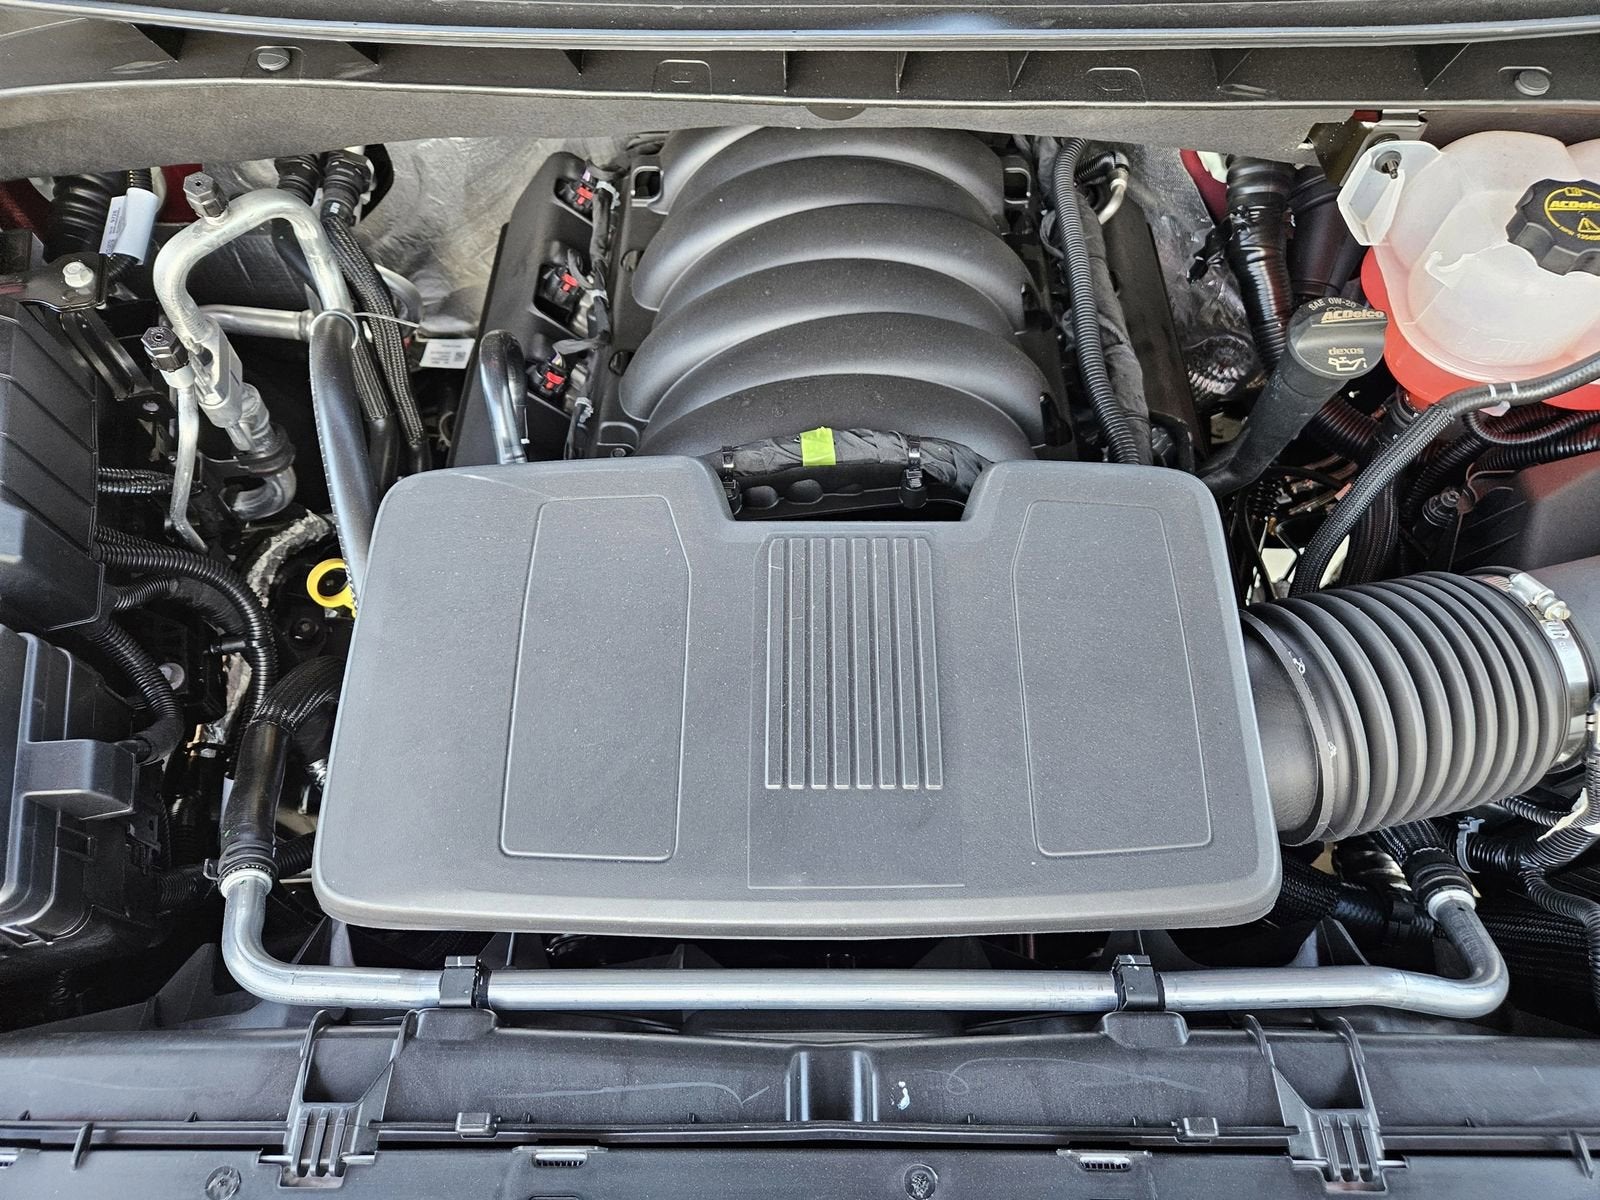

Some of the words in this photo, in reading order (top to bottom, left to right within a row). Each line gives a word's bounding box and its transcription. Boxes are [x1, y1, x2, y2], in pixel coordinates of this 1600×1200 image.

[1549, 200, 1600, 209] ACDelc
[1308, 298, 1326, 311] SAE
[1328, 297, 1357, 308] 0W-20
[1321, 309, 1385, 321] ACDelco
[1328, 347, 1365, 355] dexos
